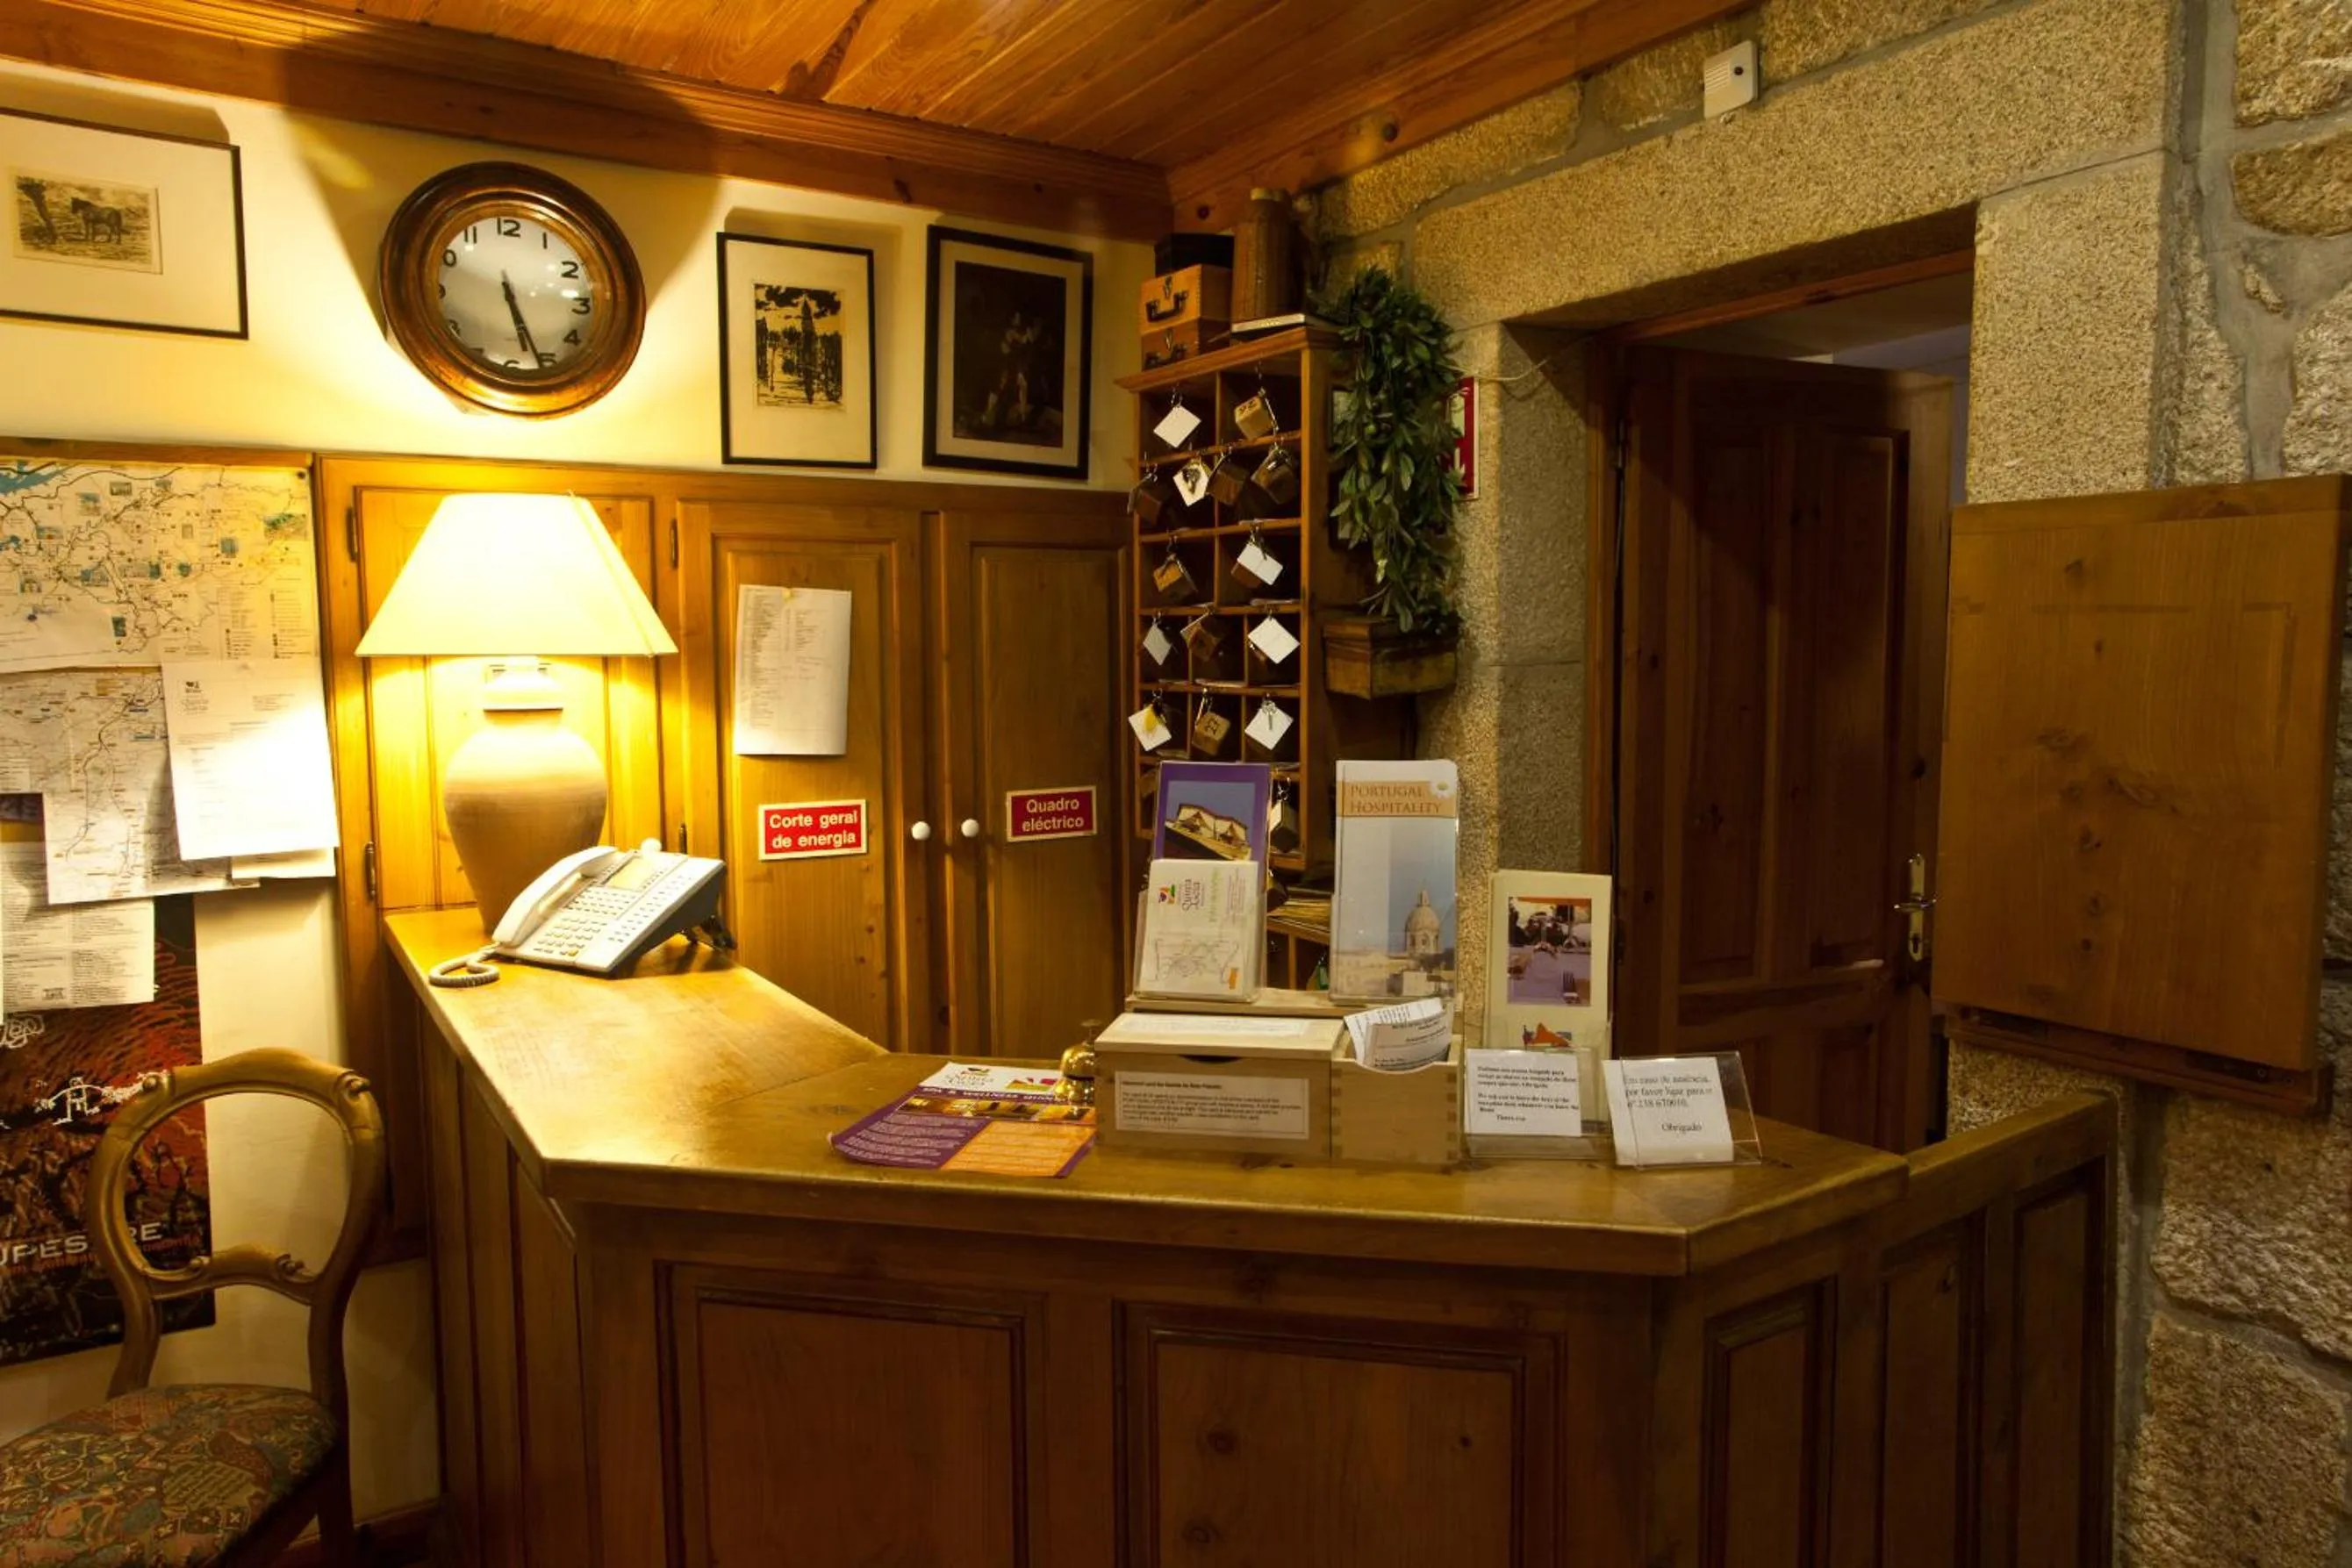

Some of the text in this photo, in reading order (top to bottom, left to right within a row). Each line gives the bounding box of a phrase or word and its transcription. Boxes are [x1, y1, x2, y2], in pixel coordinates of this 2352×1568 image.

[463, 226, 477, 244] 11
[497, 218, 521, 237] 12
[541, 232, 548, 249] 1
[561, 261, 579, 279] 2
[571, 297, 591, 314] 3
[563, 329, 581, 346] 4
[1350, 785, 1423, 798] PORTUGAL
[1026, 797, 1080, 813] Quadro
[1350, 801, 1441, 814] HOSPITALITY
[769, 809, 858, 828] Corte geral
[1022, 815, 1085, 832] eléctrico
[771, 829, 857, 849] de energia
